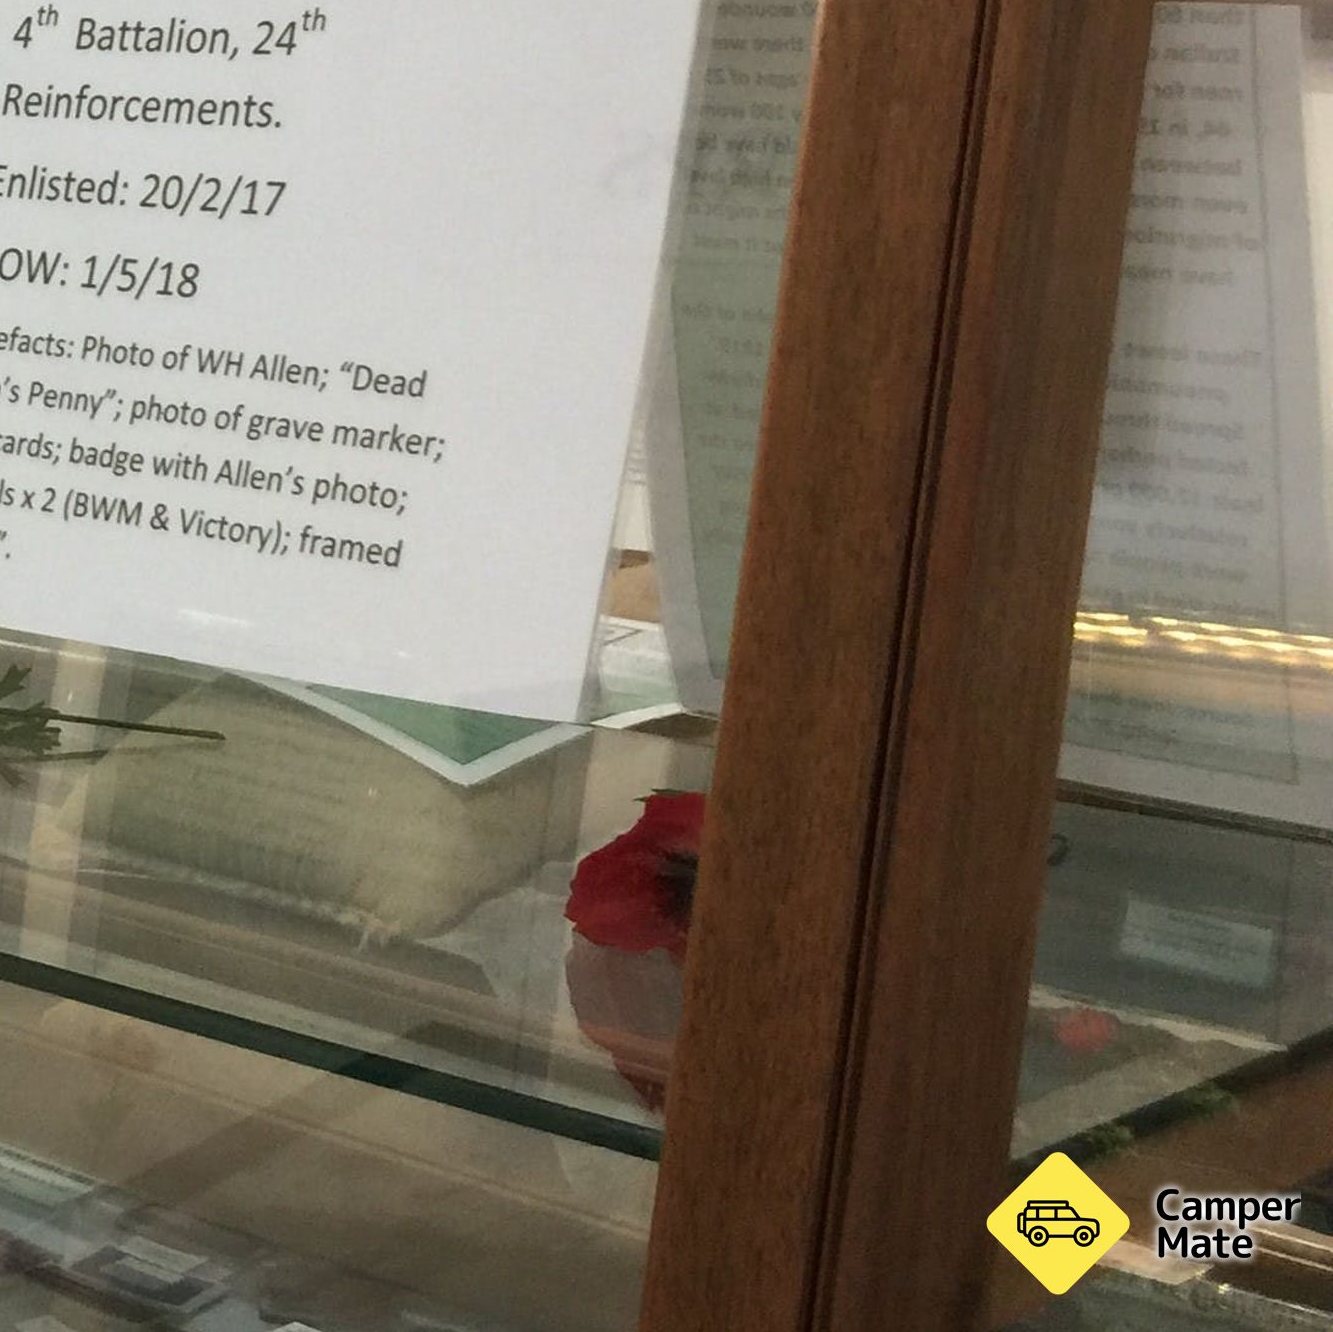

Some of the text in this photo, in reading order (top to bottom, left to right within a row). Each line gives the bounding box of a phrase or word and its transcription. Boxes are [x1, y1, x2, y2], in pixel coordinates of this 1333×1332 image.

[13, 4, 326, 60] 4th Battalion, 24th
[2, 84, 281, 128] Reinforcements.
[139, 173, 286, 219] 20/2/17
[81, 254, 200, 300] 1/5/18
[81, 336, 154, 367] Photo
[162, 345, 192, 371] of
[198, 348, 244, 377] WH
[249, 354, 329, 392] Allen;
[129, 394, 206, 427] photo
[215, 404, 245, 431] of
[246, 414, 324, 442] grave
[332, 424, 445, 463] marker;
[69, 437, 144, 477] badge
[153, 452, 208, 481] with
[214, 460, 304, 495] Allen’s
[311, 473, 407, 516] photo;
[21, 491, 35, 509] x
[41, 488, 55, 513] 2
[64, 489, 143, 526] (BWM
[149, 505, 170, 531] &
[181, 508, 290, 555] Victory);
[299, 525, 403, 567] framed
